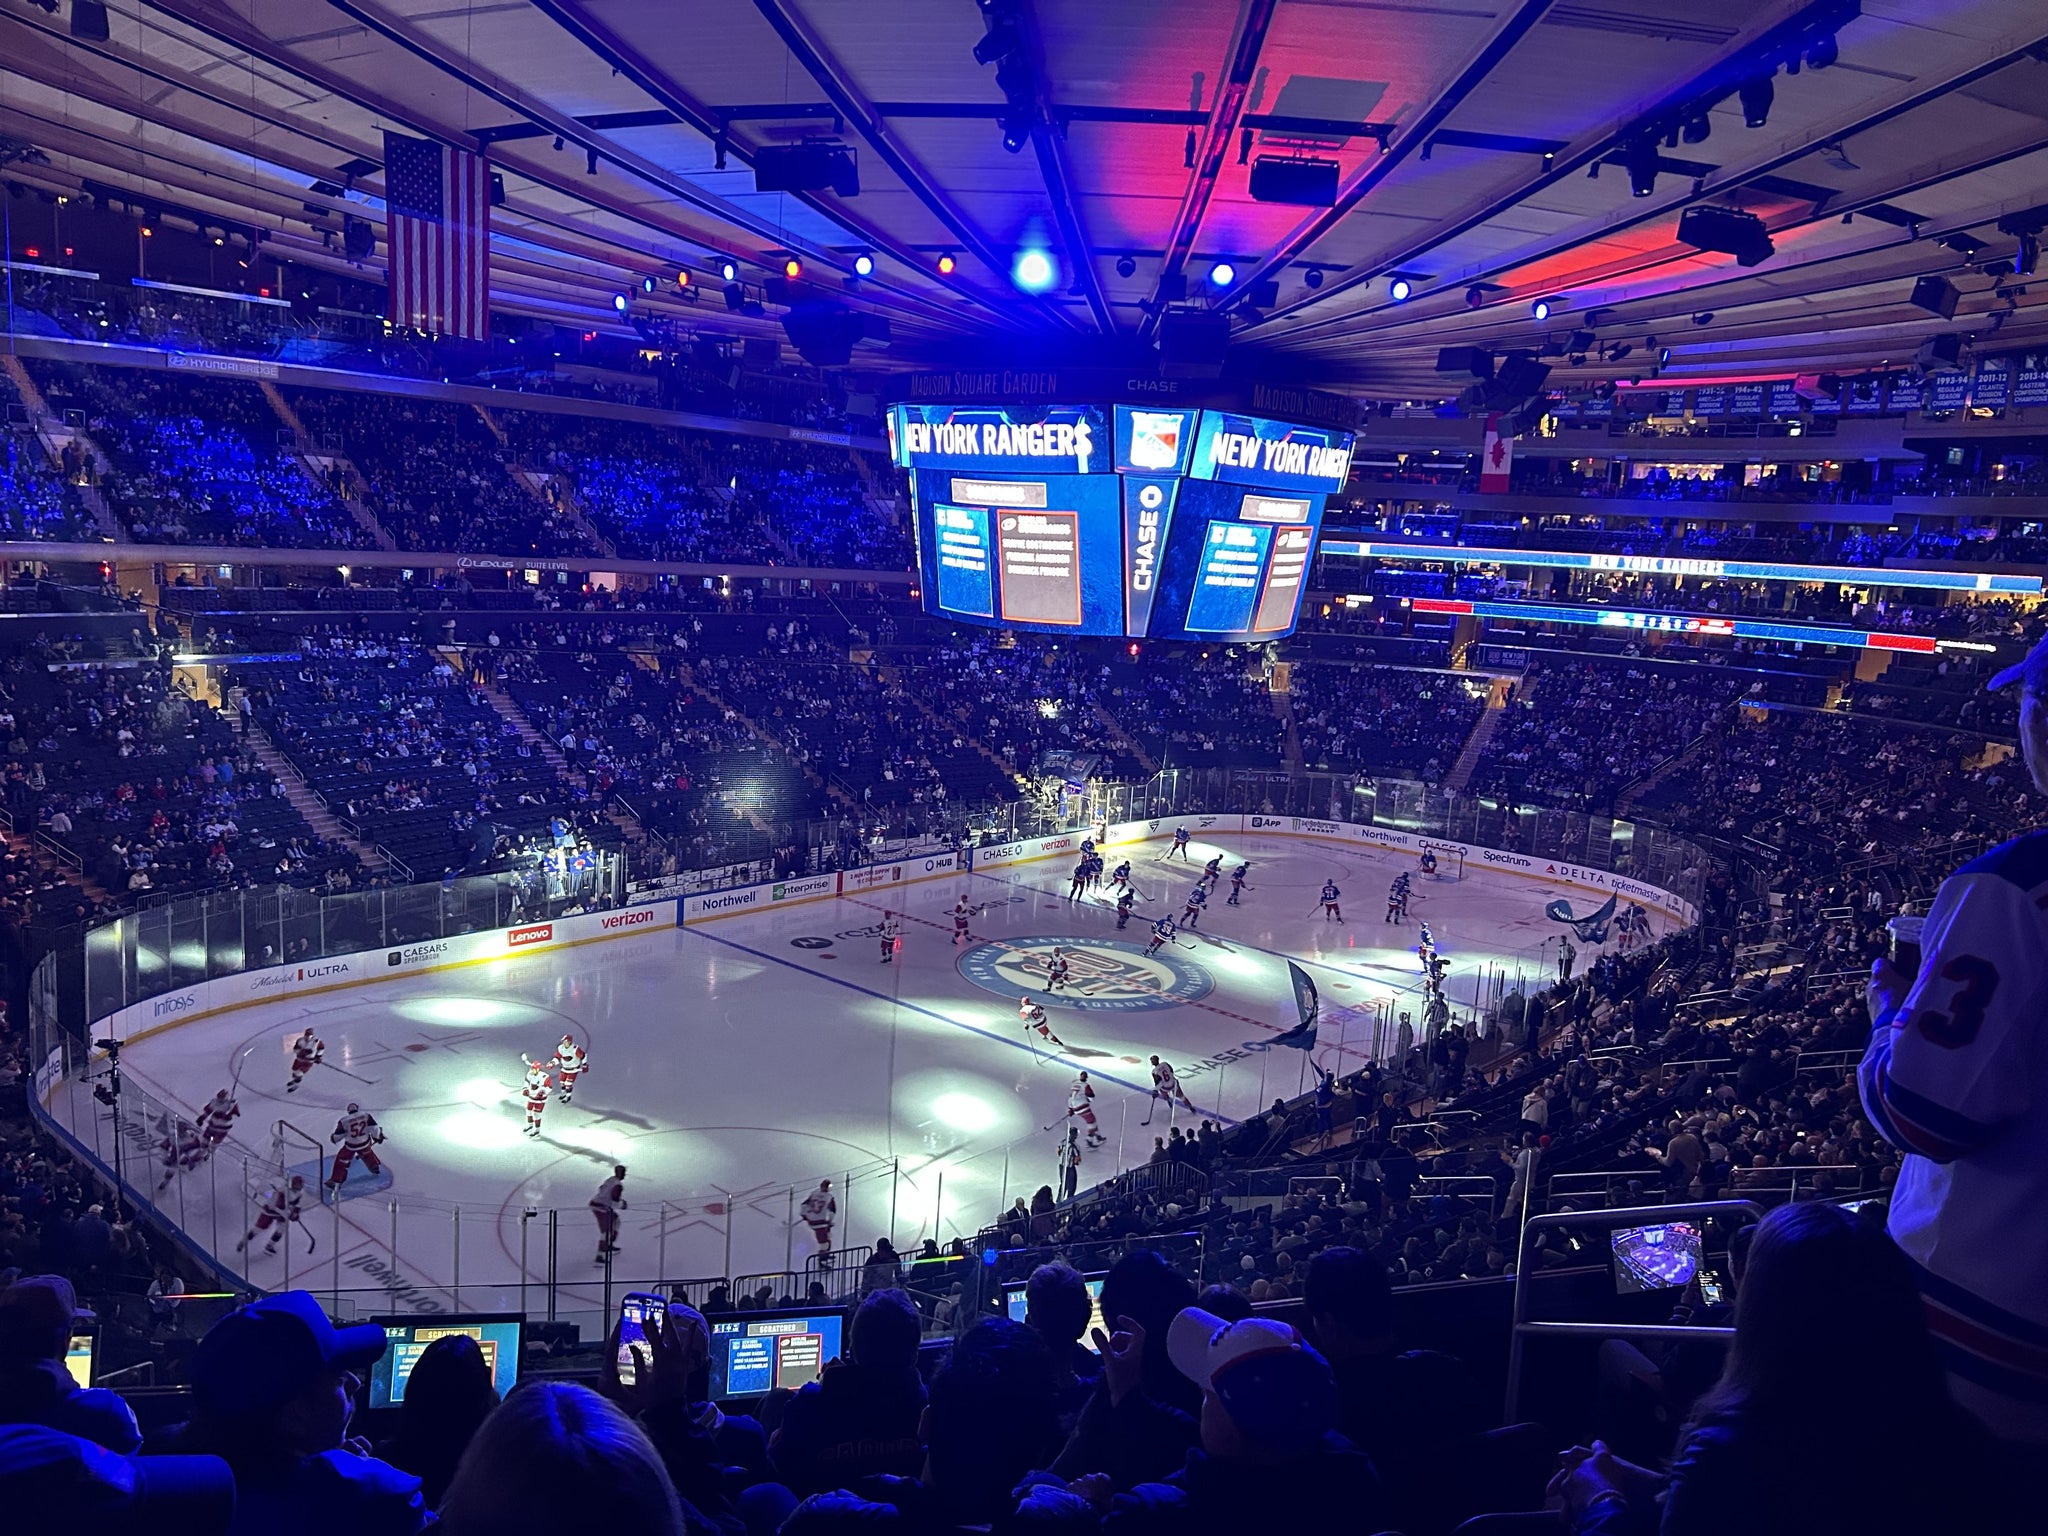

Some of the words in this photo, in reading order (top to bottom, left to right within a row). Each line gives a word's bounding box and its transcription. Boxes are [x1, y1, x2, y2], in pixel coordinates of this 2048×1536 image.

[190, 359, 239, 371] HYUNDAI
[241, 363, 277, 376] BRIDGE
[911, 375, 951, 396] MADISON
[953, 371, 998, 396] SQUARE
[1003, 370, 1057, 396] GARDEN
[1127, 379, 1178, 393] CHASE
[1936, 375, 1968, 385] 1993-94
[1978, 373, 2007, 382] 2011-12
[1978, 383, 2005, 391] ATLANTIC
[1253, 383, 1304, 414] MADISON
[904, 423, 931, 453] NEW
[933, 423, 979, 455] YORK
[983, 423, 1093, 457] RANGERS
[1210, 432, 1262, 469] NEW
[1264, 439, 1310, 475] YORK
[1133, 510, 1158, 591] CHASE
[473, 560, 514, 568] LEXUS
[526, 561, 546, 569] SUITE
[548, 562, 569, 570] LEVEL
[1265, 776, 1290, 784] ULTRA
[1041, 837, 1071, 850] verizon
[1362, 829, 1408, 844] Northwell
[936, 857, 952, 868] HUB
[983, 849, 1014, 861] CHASE
[1484, 850, 1528, 867] Spectrum
[1561, 866, 1605, 884] DELTA
[776, 879, 829, 897] enterprise
[1611, 877, 1661, 902] ticketmaster
[702, 891, 757, 911] Northwell
[601, 910, 654, 929] verizon
[510, 930, 549, 944] Lenovo
[404, 943, 448, 958] CAESARS
[404, 953, 440, 965] SPORTSBOOK
[307, 962, 349, 978] ULTRA
[154, 993, 195, 1017] Infosys
[1917, 954, 2000, 1050] 3
[1174, 1048, 1254, 1080] CHASE
[350, 1120, 367, 1139] 52
[343, 1254, 447, 1313] orthwell
[759, 1324, 797, 1334] SCRATCHES
